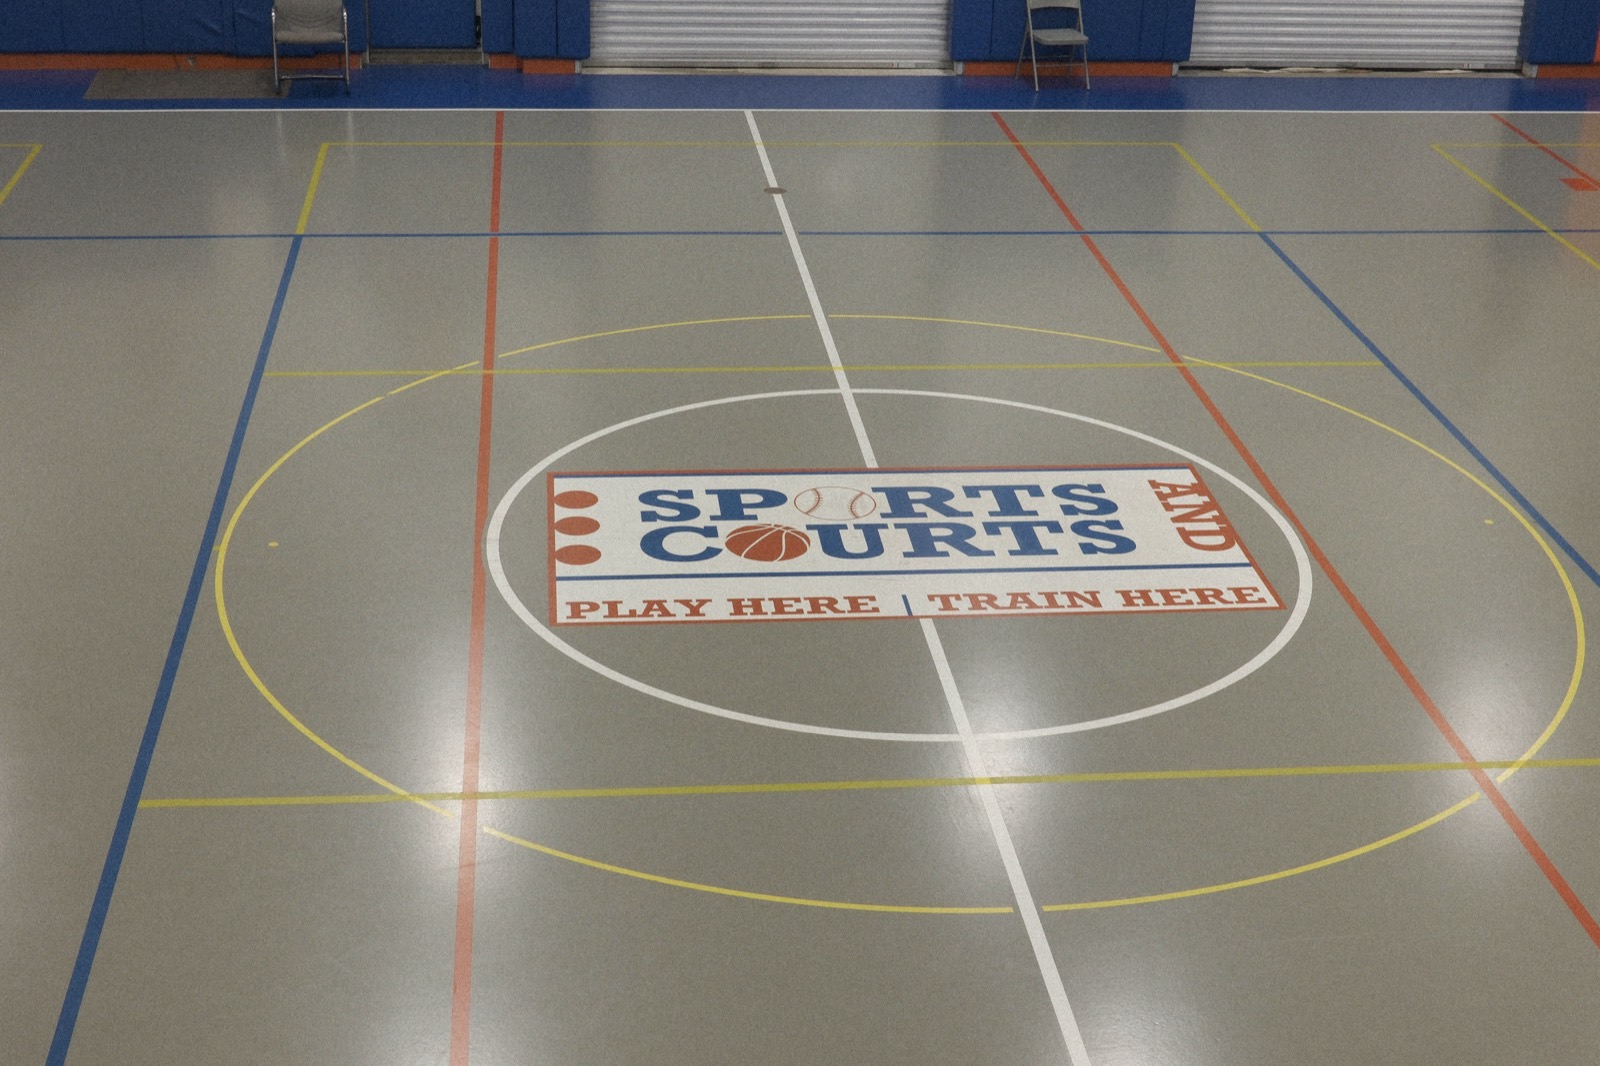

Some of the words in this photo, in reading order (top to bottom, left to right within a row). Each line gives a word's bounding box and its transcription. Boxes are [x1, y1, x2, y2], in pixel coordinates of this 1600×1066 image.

[1148, 479, 1236, 552] AND
[565, 599, 713, 619] PLAY
[729, 595, 880, 616] HERE
[927, 590, 1103, 611] TRAIN
[1115, 586, 1268, 607] HERE
